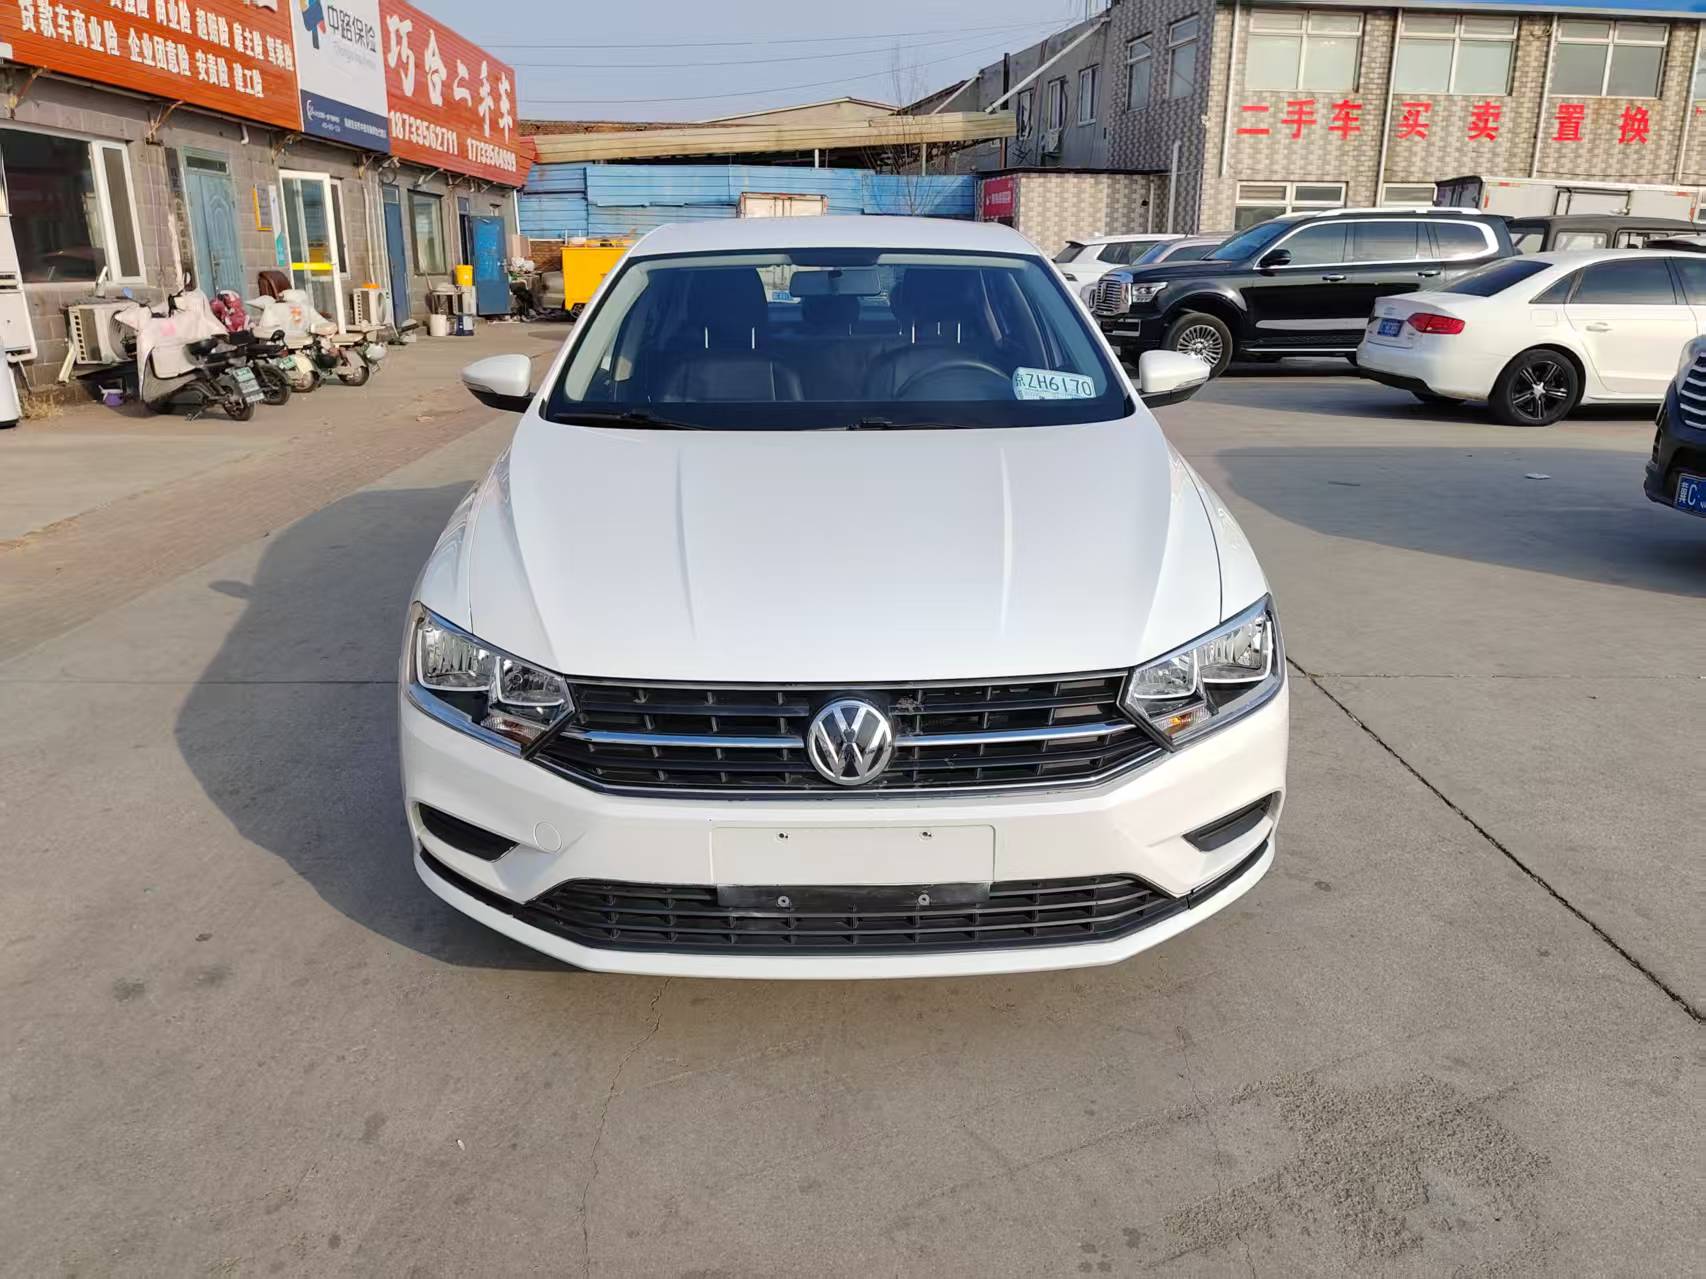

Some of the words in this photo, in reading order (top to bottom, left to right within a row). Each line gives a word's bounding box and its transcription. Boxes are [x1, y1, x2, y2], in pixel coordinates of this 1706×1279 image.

[327, 4, 377, 53] 中路保险
[388, 109, 459, 155] 18733562711
[1236, 99, 1363, 140] 二手车
